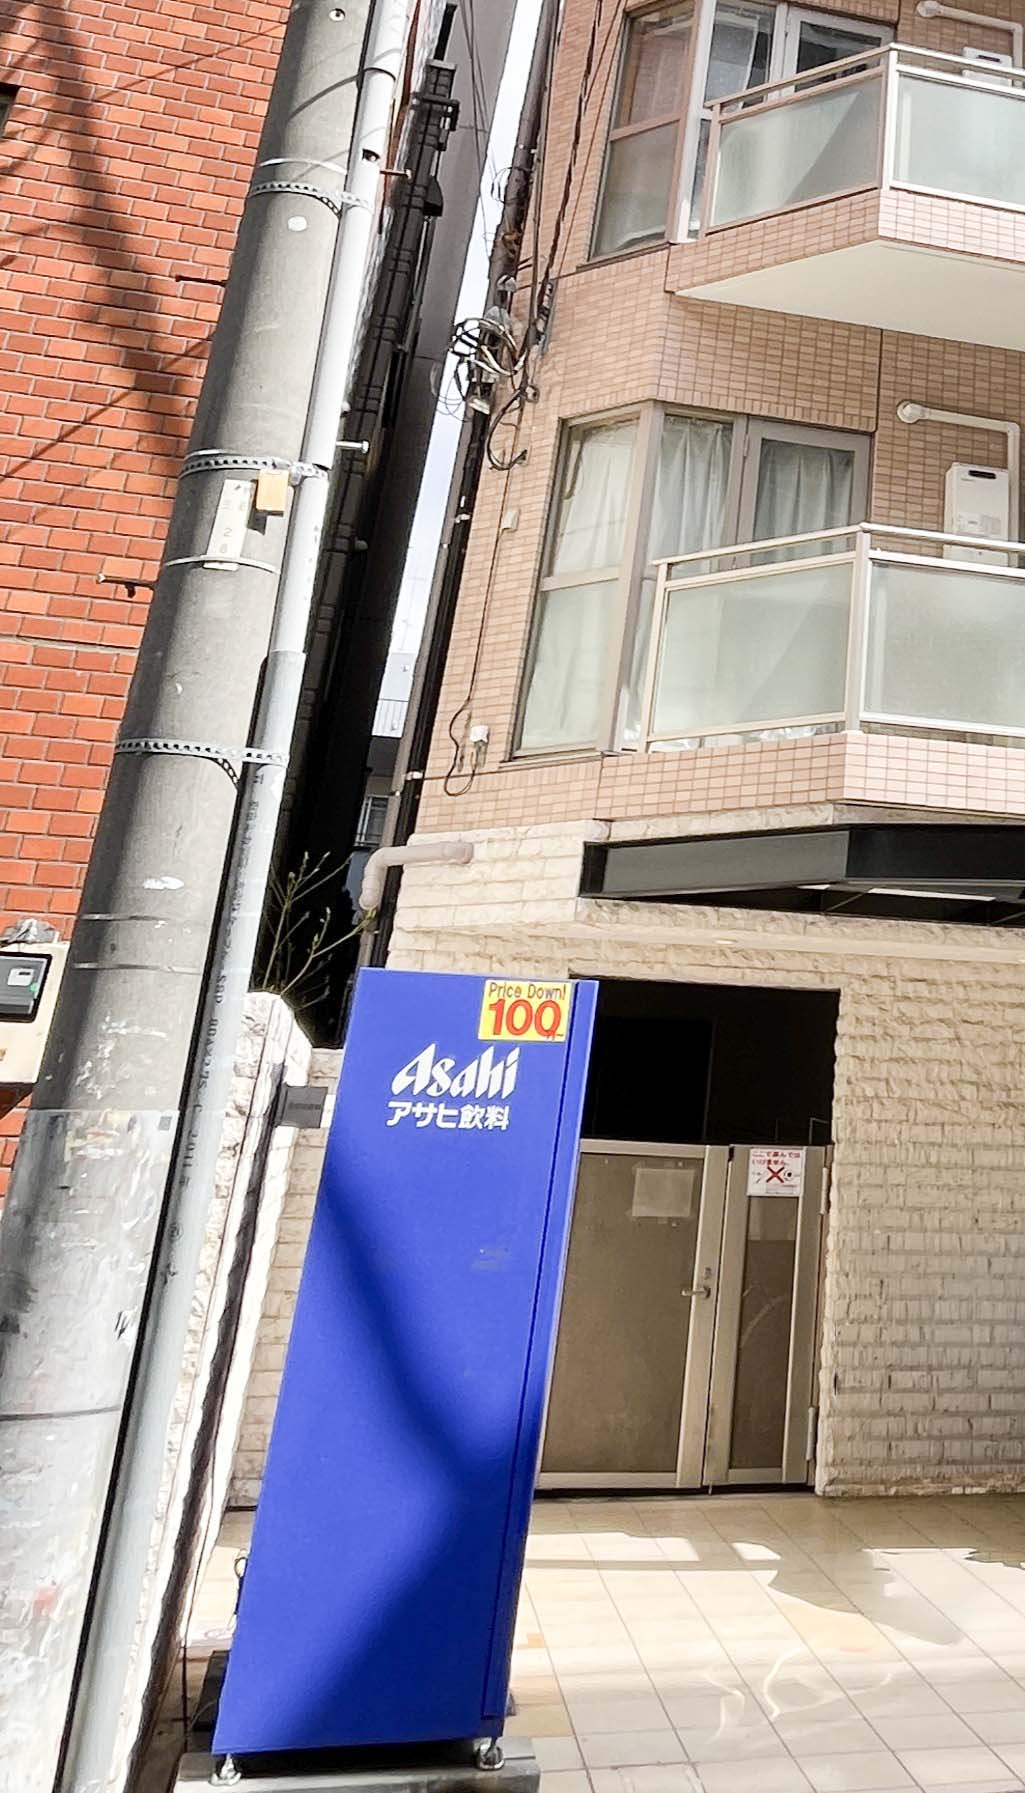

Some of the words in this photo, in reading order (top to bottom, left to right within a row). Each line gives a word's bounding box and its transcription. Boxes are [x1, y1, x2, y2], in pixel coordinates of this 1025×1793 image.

[488, 982, 522, 998] Price
[527, 983, 567, 1001] Down!
[488, 998, 562, 1037] 100
[391, 1043, 520, 1100] Asahi
[386, 1101, 511, 1131] アサヒ飲料
